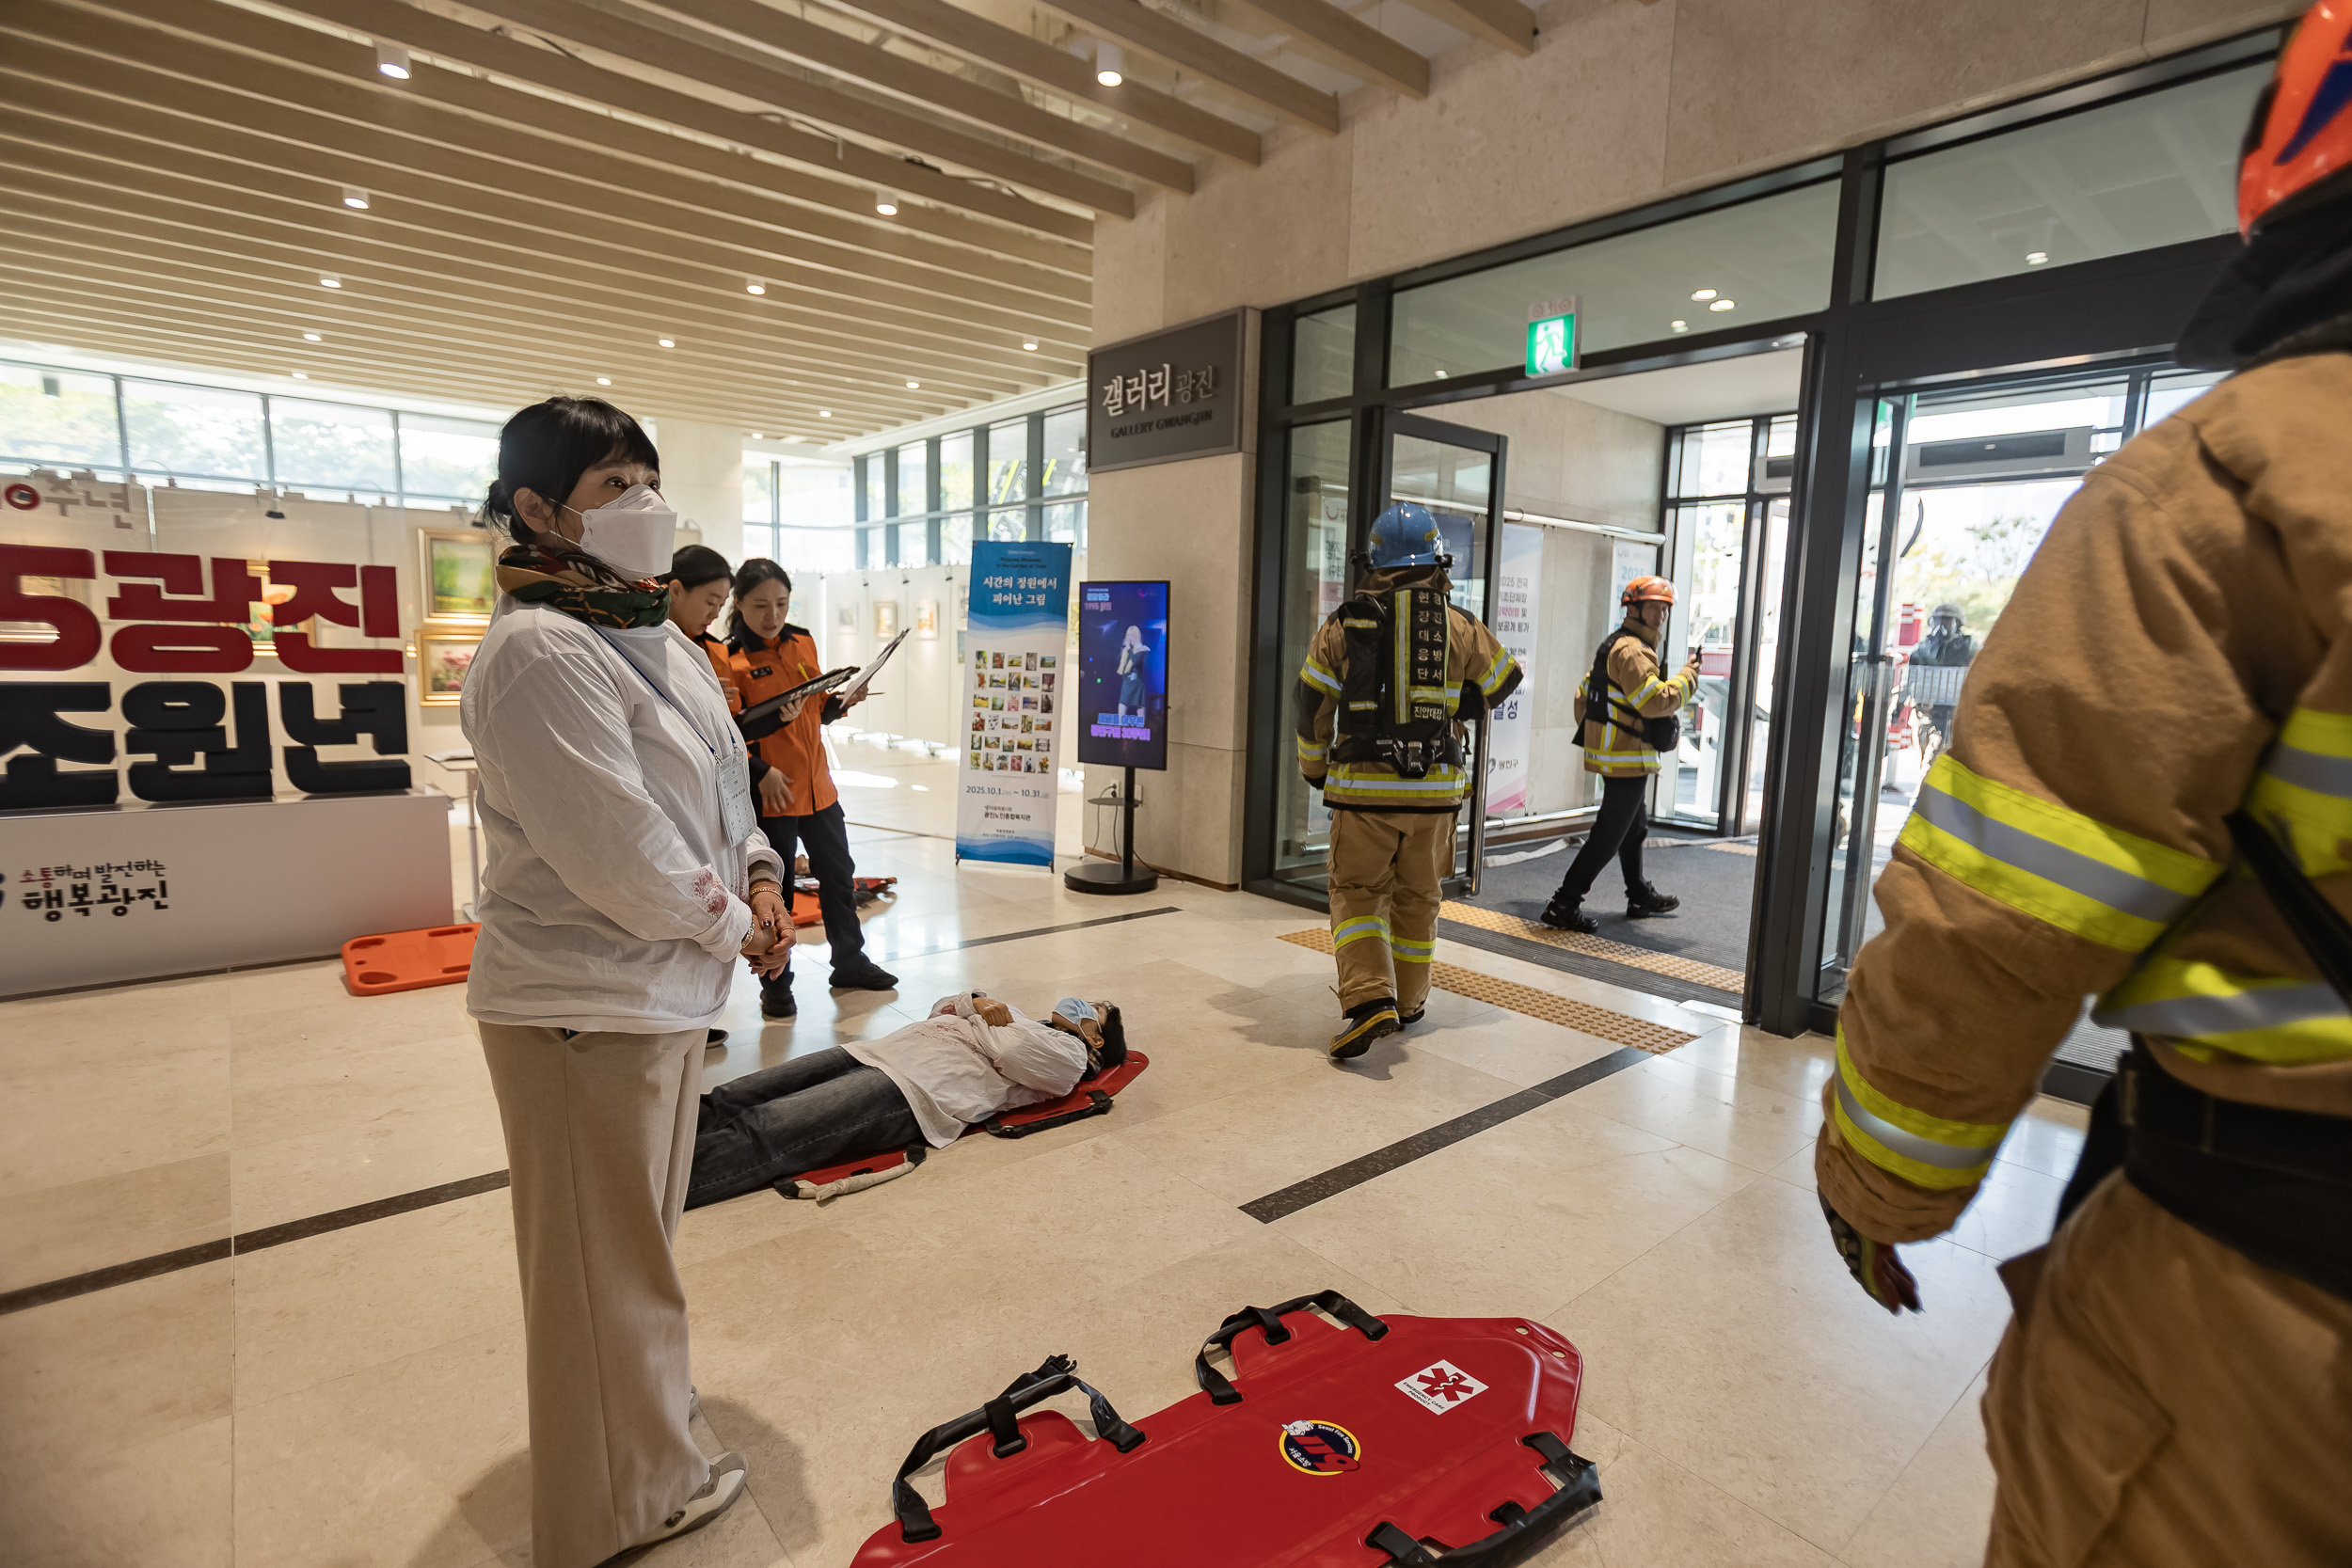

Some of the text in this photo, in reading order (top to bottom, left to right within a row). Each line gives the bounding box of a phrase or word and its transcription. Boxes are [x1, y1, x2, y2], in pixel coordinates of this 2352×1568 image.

[1101, 362, 1213, 417] 갤러리 광진
[1110, 409, 1213, 438] GALLERY GWANGJIN
[983, 576, 1057, 590] 시간의 정원에서
[993, 593, 1046, 606] 피어난 그림
[1501, 592, 1528, 603] 초단체장
[1417, 591, 1429, 680] 현장대응단
[1432, 593, 1442, 681] 광진소방서
[1414, 705, 1443, 721] 진압대장
[19, 859, 167, 889] 소통하며 발전하는
[22, 879, 169, 923] 행복광진
[1403, 1382, 1445, 1410] EMERGENCY CARE
[1407, 1390, 1431, 1406] PRODUCT
[1318, 1424, 1335, 1433] Seoul
[1334, 1429, 1344, 1438] Fire
